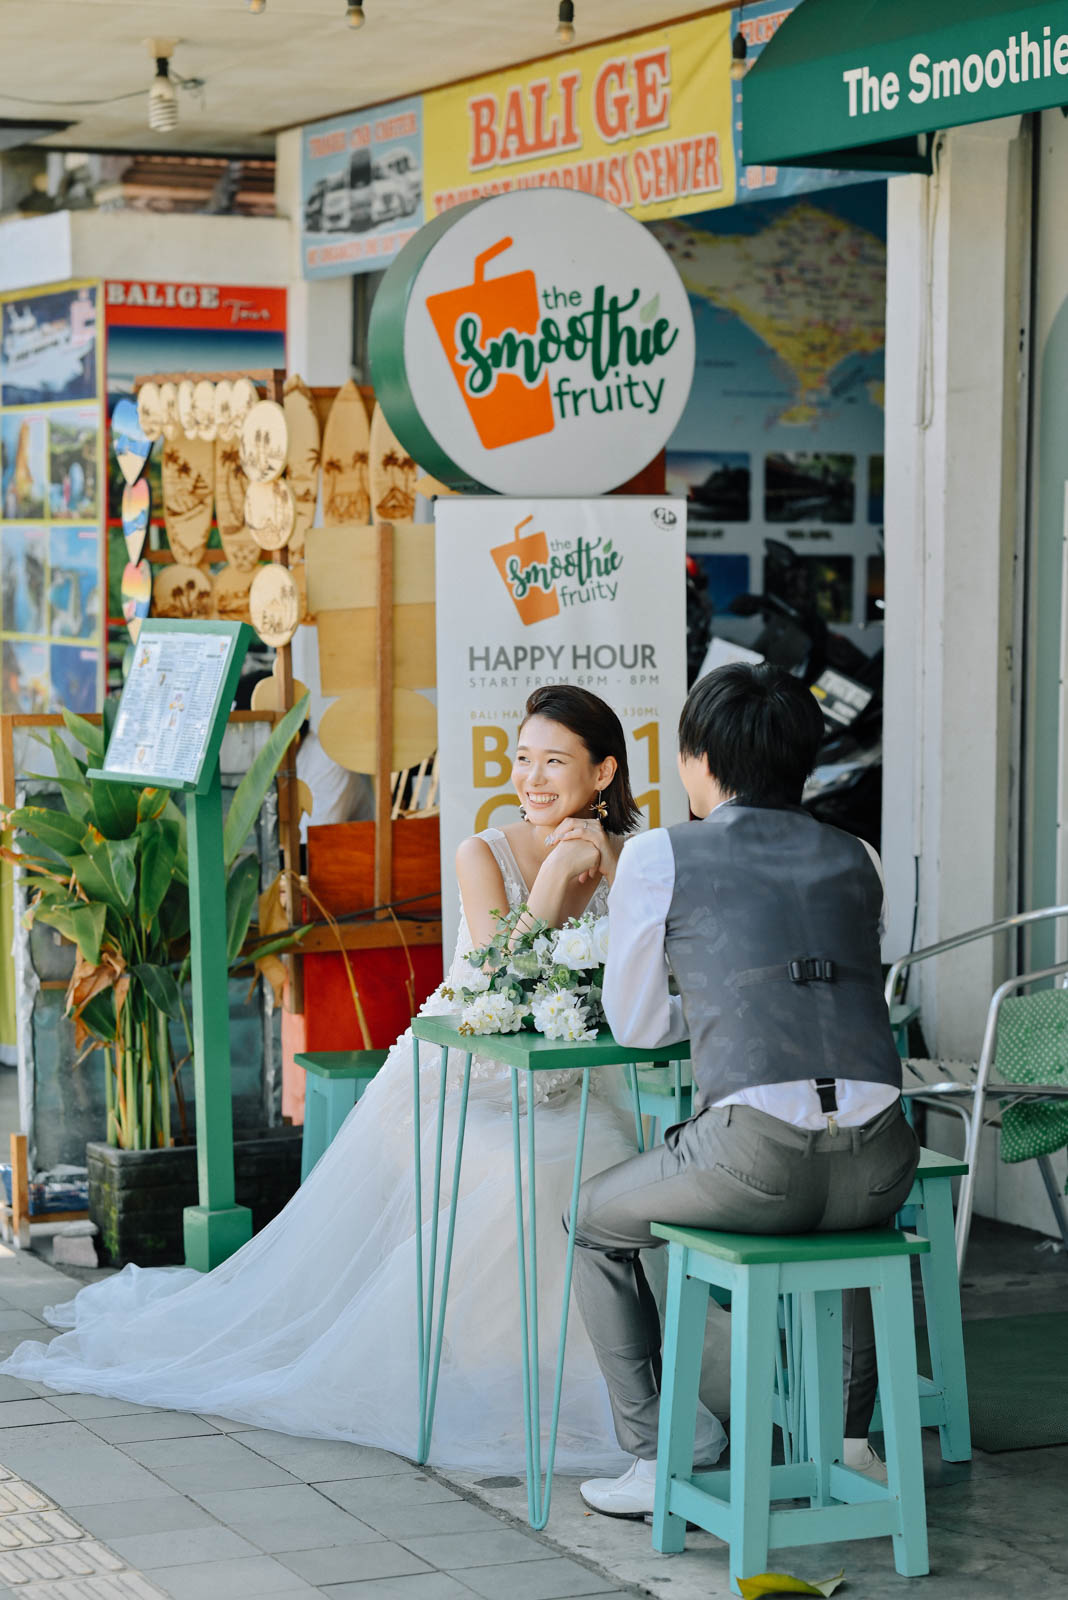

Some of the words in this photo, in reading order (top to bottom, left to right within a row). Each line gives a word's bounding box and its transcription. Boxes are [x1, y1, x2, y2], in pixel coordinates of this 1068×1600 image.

[843, 66, 899, 117] The
[908, 26, 1068, 104] Smoothie
[471, 73, 580, 168] BALI
[596, 50, 670, 141] GE
[633, 136, 718, 201] CENTER
[107, 283, 219, 308] BALIGE
[543, 286, 582, 309] the
[554, 371, 665, 418] fruity
[550, 540, 571, 551] the
[560, 581, 618, 607] fruity
[469, 645, 565, 671] HAPPY
[572, 644, 657, 670] HOUR
[469, 677, 518, 688] START
[526, 676, 569, 686] FROM
[577, 674, 608, 686] 6PM
[630, 675, 660, 686] 8PM
